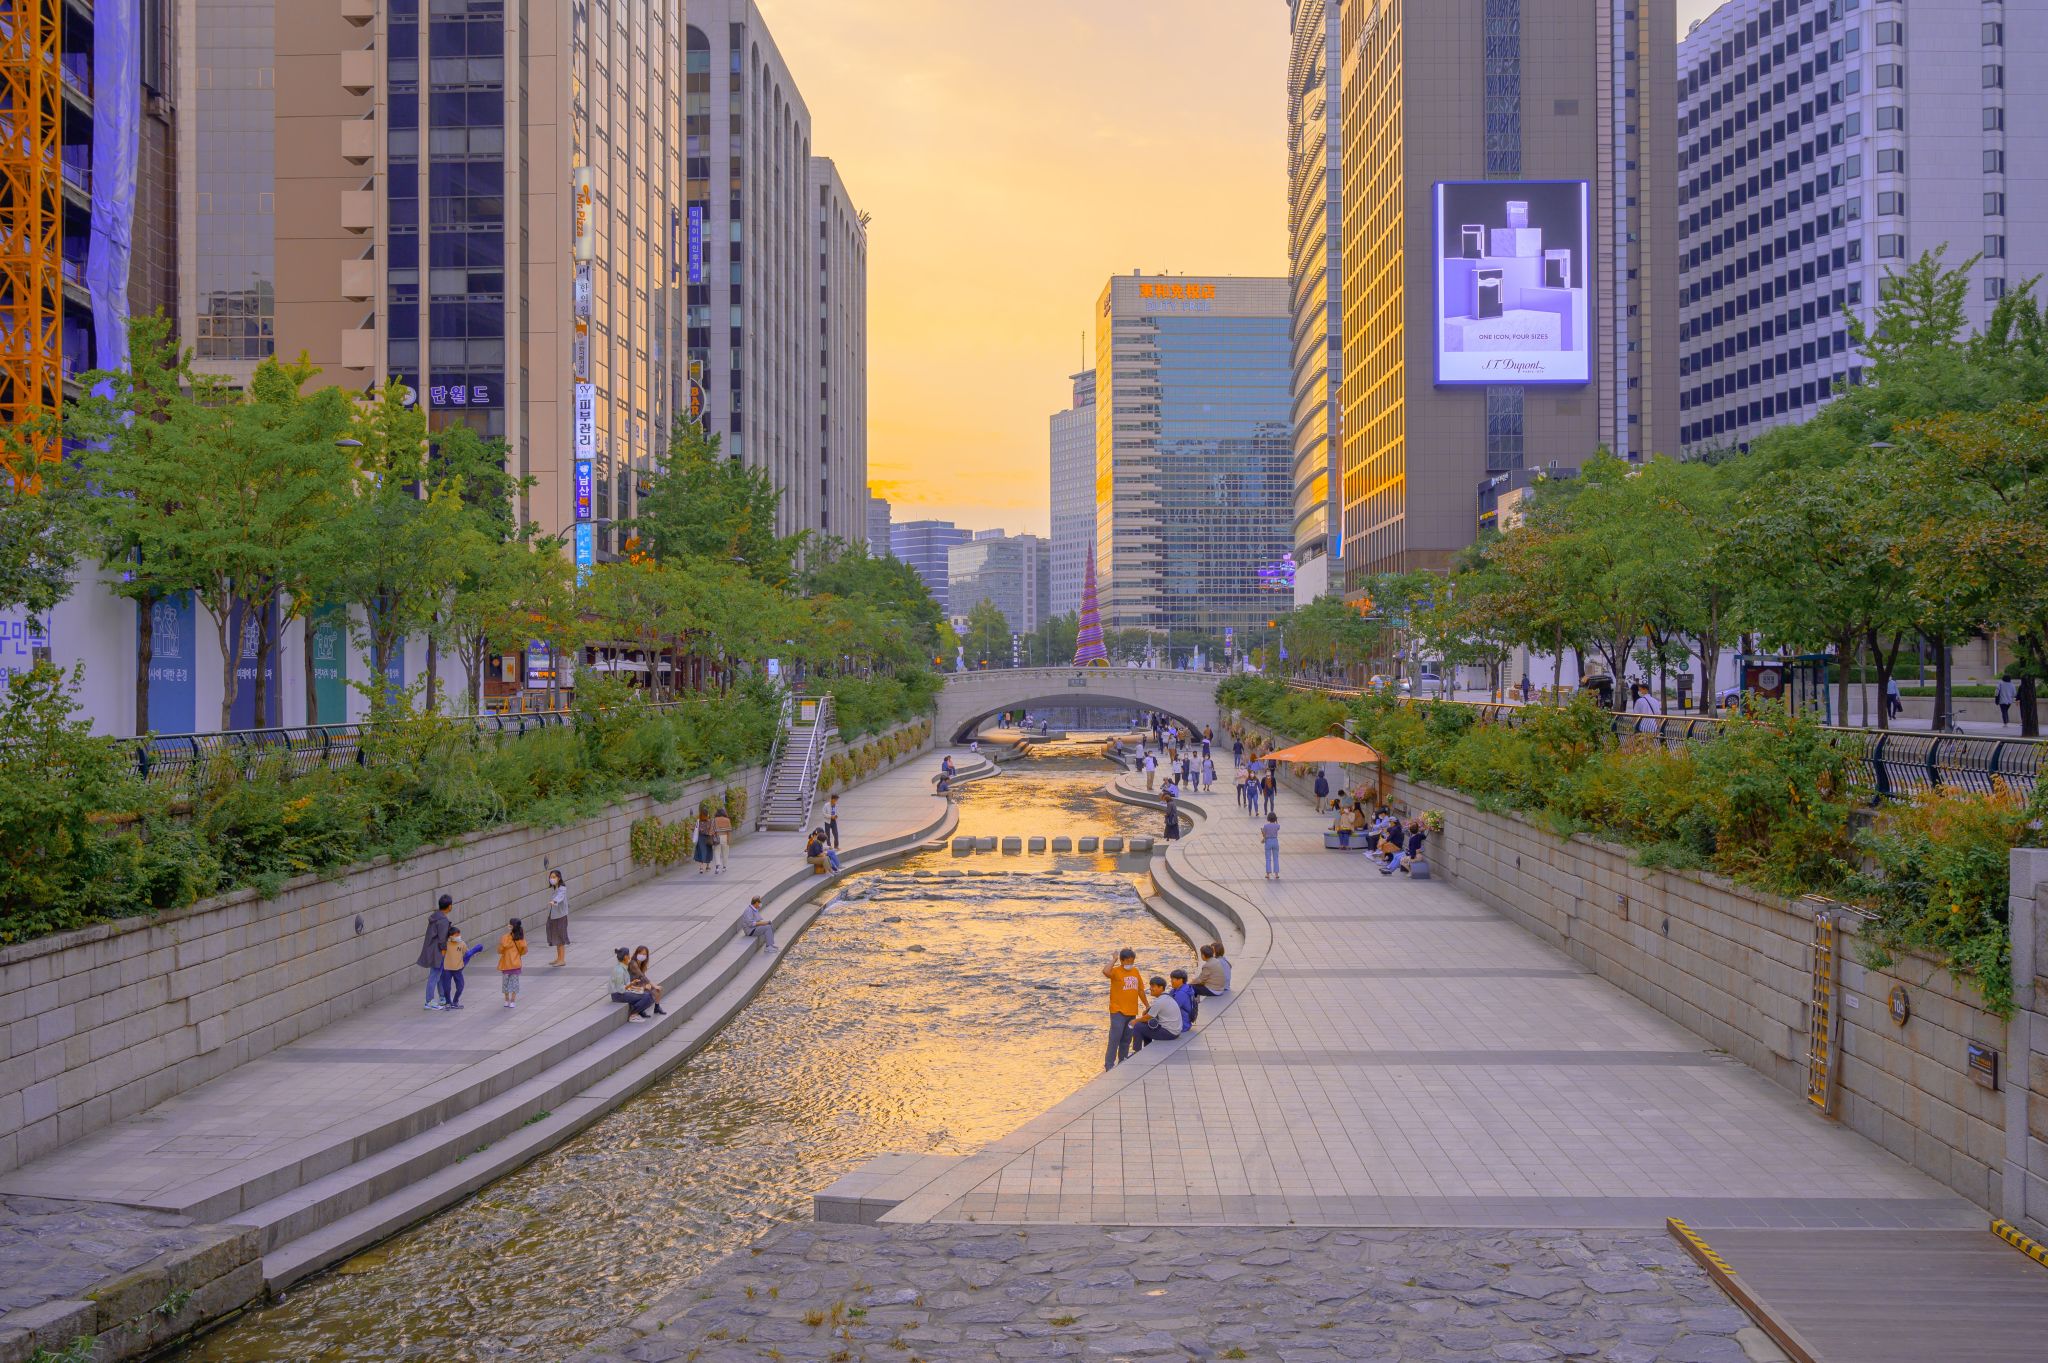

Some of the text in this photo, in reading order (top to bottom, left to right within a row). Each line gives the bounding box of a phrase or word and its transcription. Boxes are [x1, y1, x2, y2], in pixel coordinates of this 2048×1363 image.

[576, 211, 586, 237] Pizza
[580, 282, 589, 316] 한의원
[1146, 301, 1208, 312] DUTY FREE
[430, 385, 490, 405] 단월드
[691, 387, 699, 416] BAR
[579, 399, 591, 446] 피부관리
